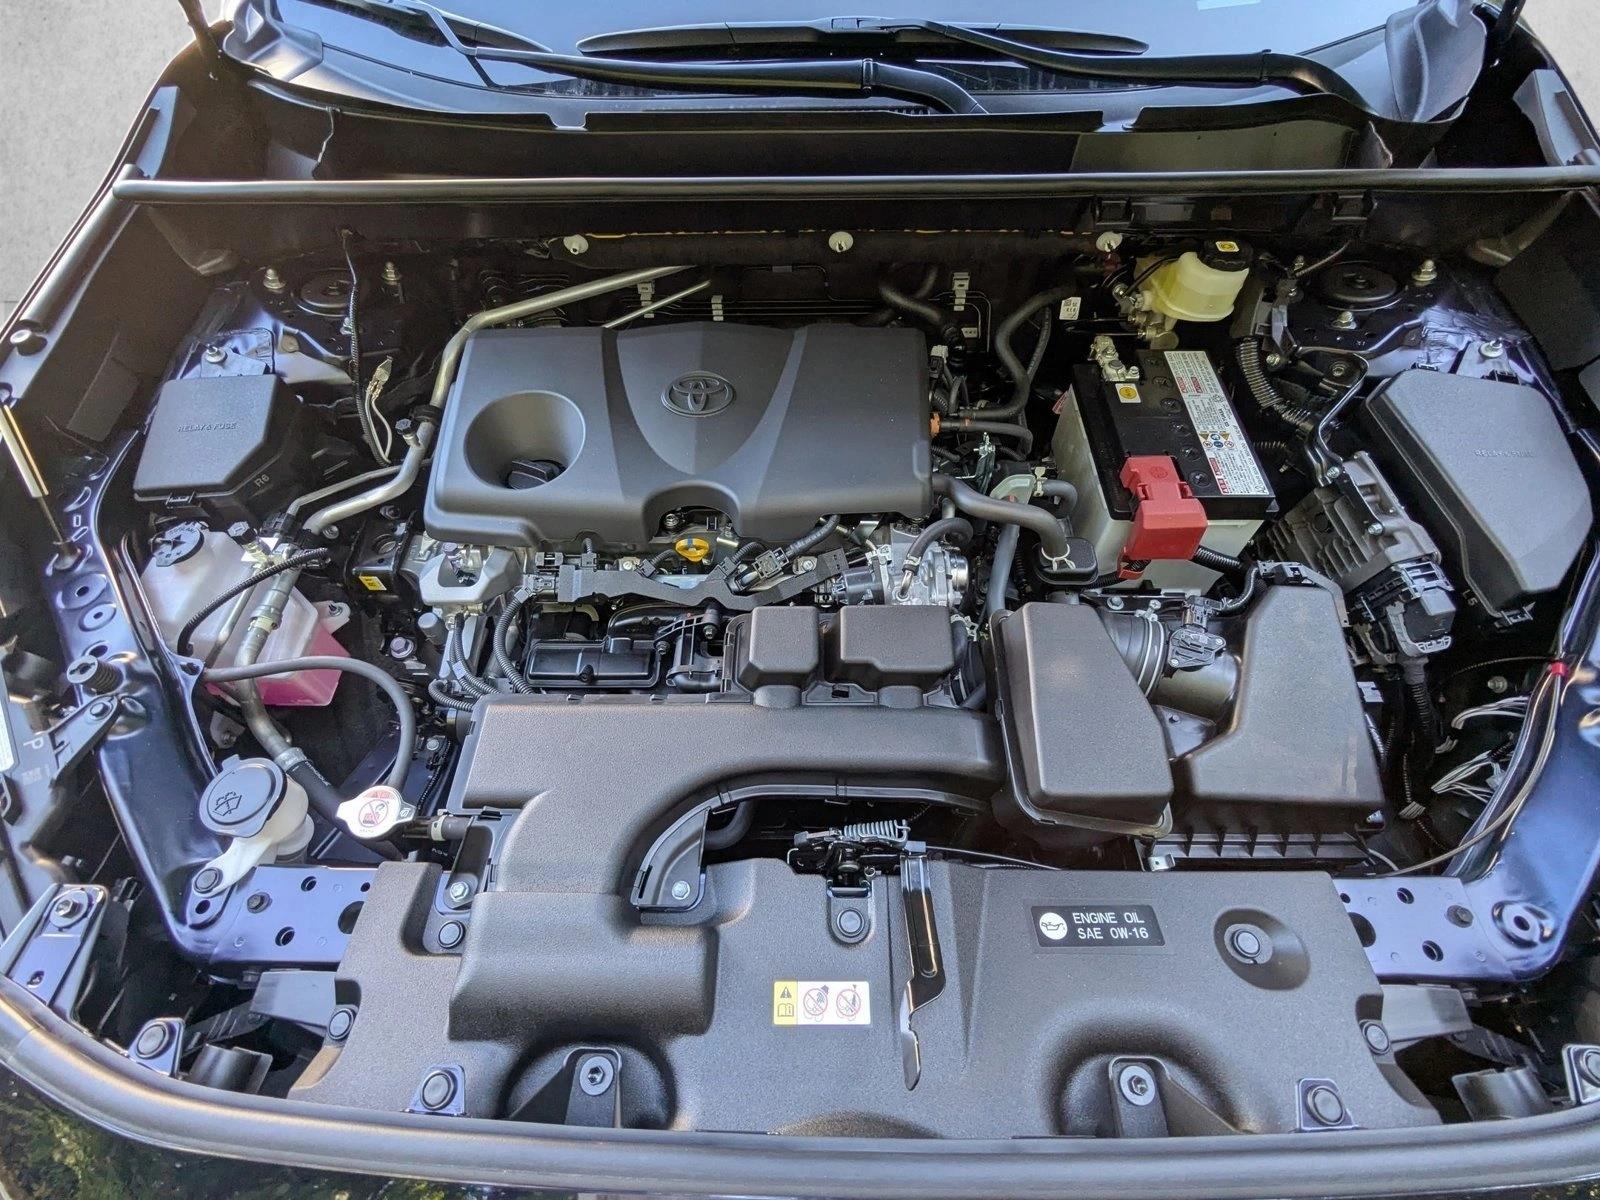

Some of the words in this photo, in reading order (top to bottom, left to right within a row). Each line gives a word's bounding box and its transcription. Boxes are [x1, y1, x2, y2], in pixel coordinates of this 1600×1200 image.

[1072, 912, 1118, 924] ENGINE
[1124, 912, 1145, 924] OIL
[1078, 927, 1104, 939] SAE
[1110, 927, 1149, 939] 0W-16
